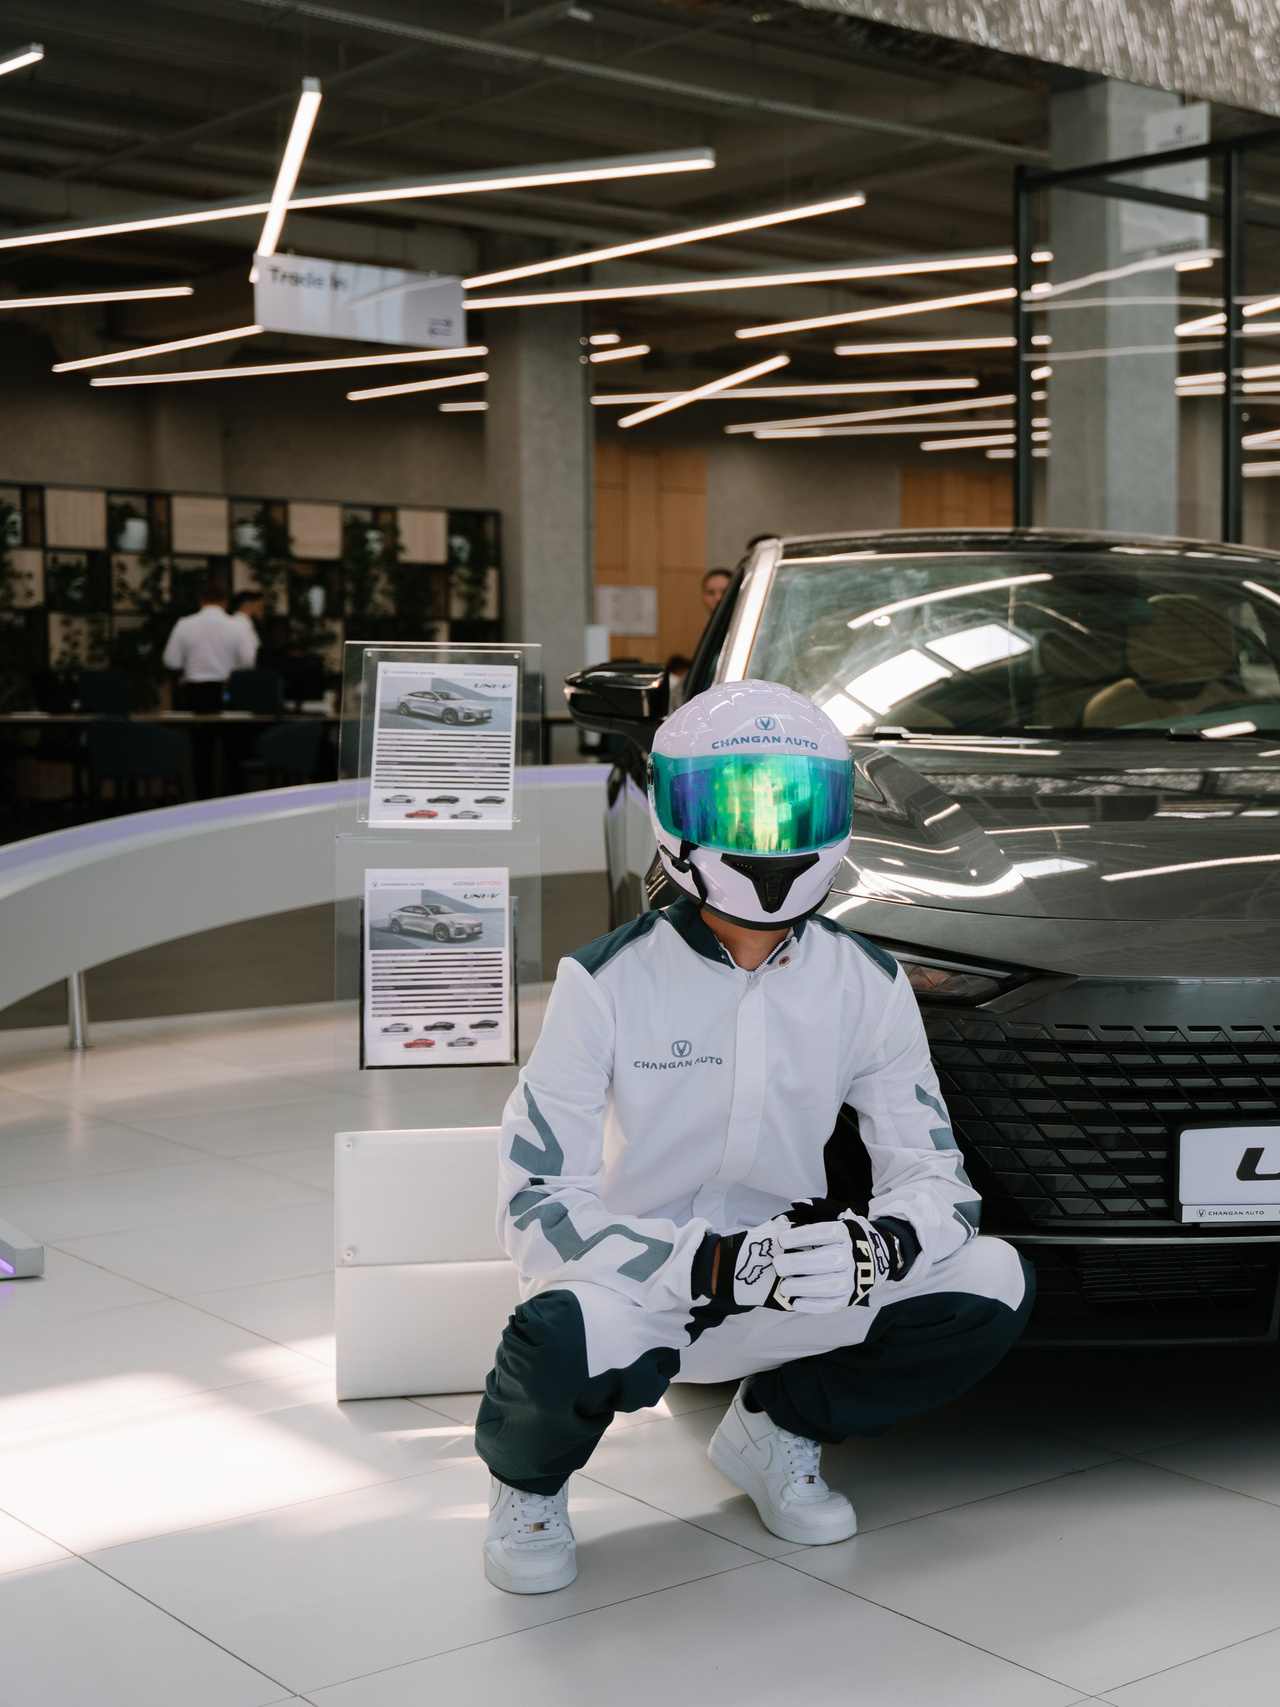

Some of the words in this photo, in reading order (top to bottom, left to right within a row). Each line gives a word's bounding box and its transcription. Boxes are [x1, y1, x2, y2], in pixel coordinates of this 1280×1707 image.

[267, 265, 325, 289] Trade
[711, 736, 781, 750] CHANGAN
[784, 737, 818, 750] AUTO
[633, 1060, 693, 1070] CHANGAN
[694, 1056, 723, 1065] AUTO
